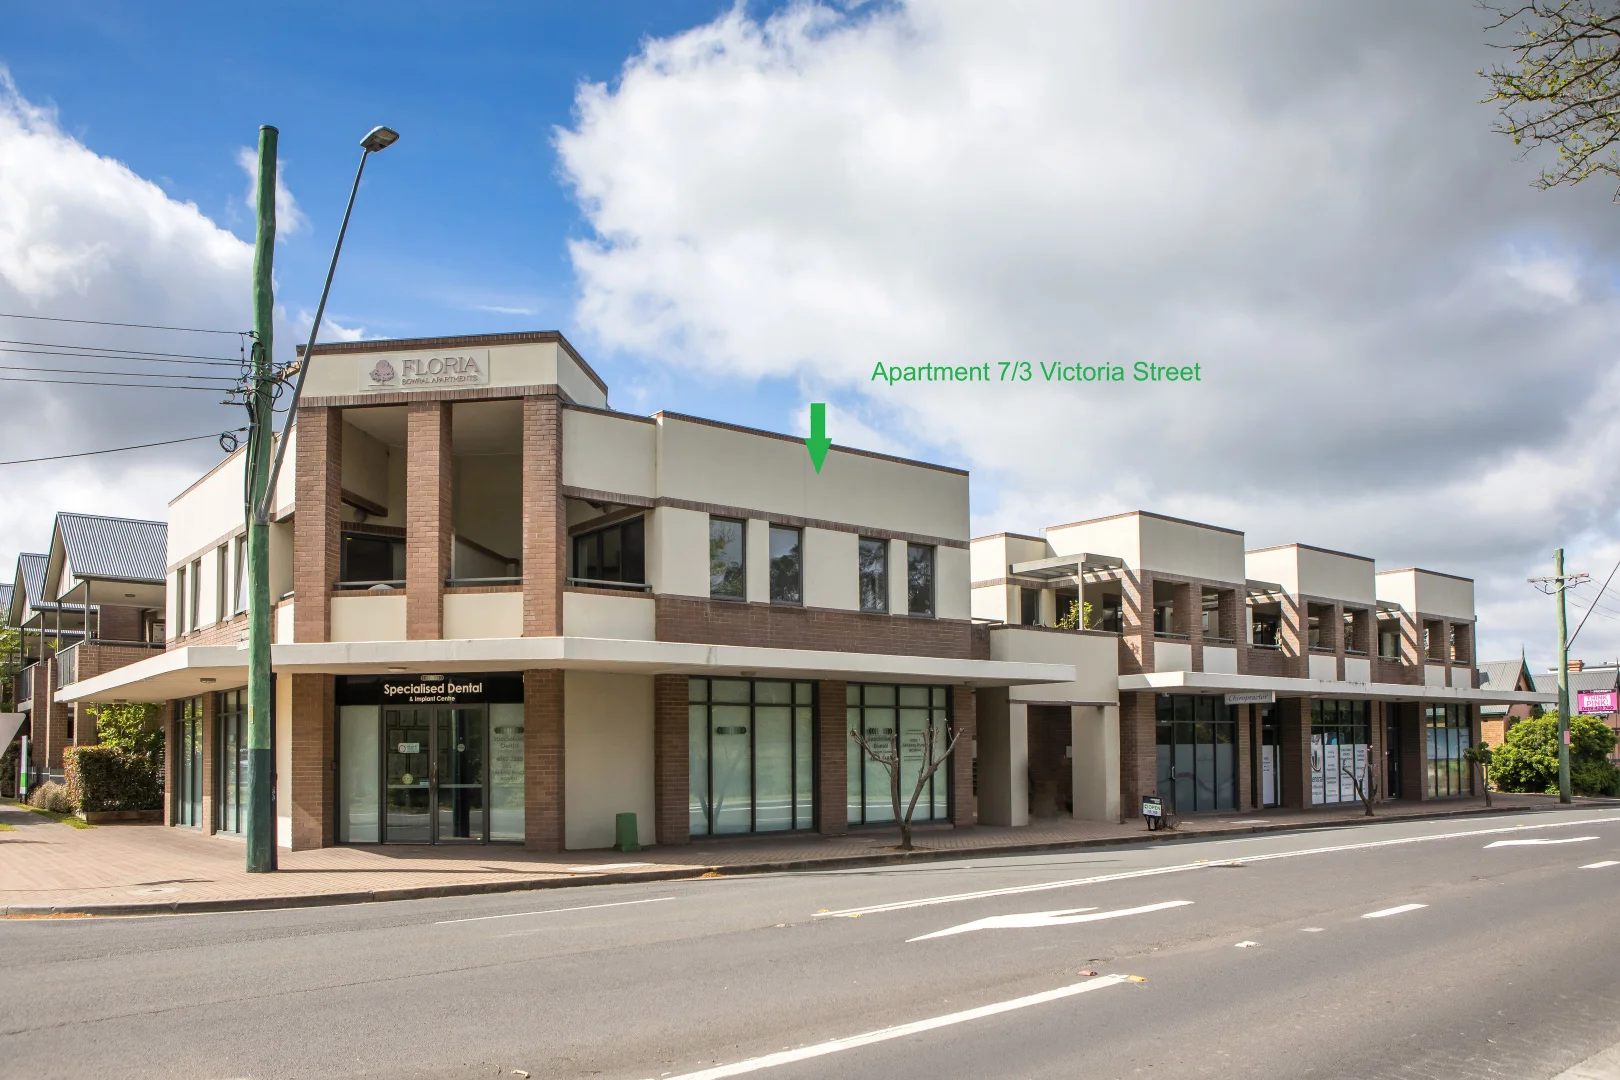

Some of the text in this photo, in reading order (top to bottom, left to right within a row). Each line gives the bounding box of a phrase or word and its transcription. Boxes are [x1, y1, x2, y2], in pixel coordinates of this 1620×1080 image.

[402, 356, 479, 376] FLORIA
[402, 375, 478, 386] BOWRAL APARTMENTS
[384, 682, 483, 696] Specialised Dental
[1228, 693, 1269, 703] Chiropractor
